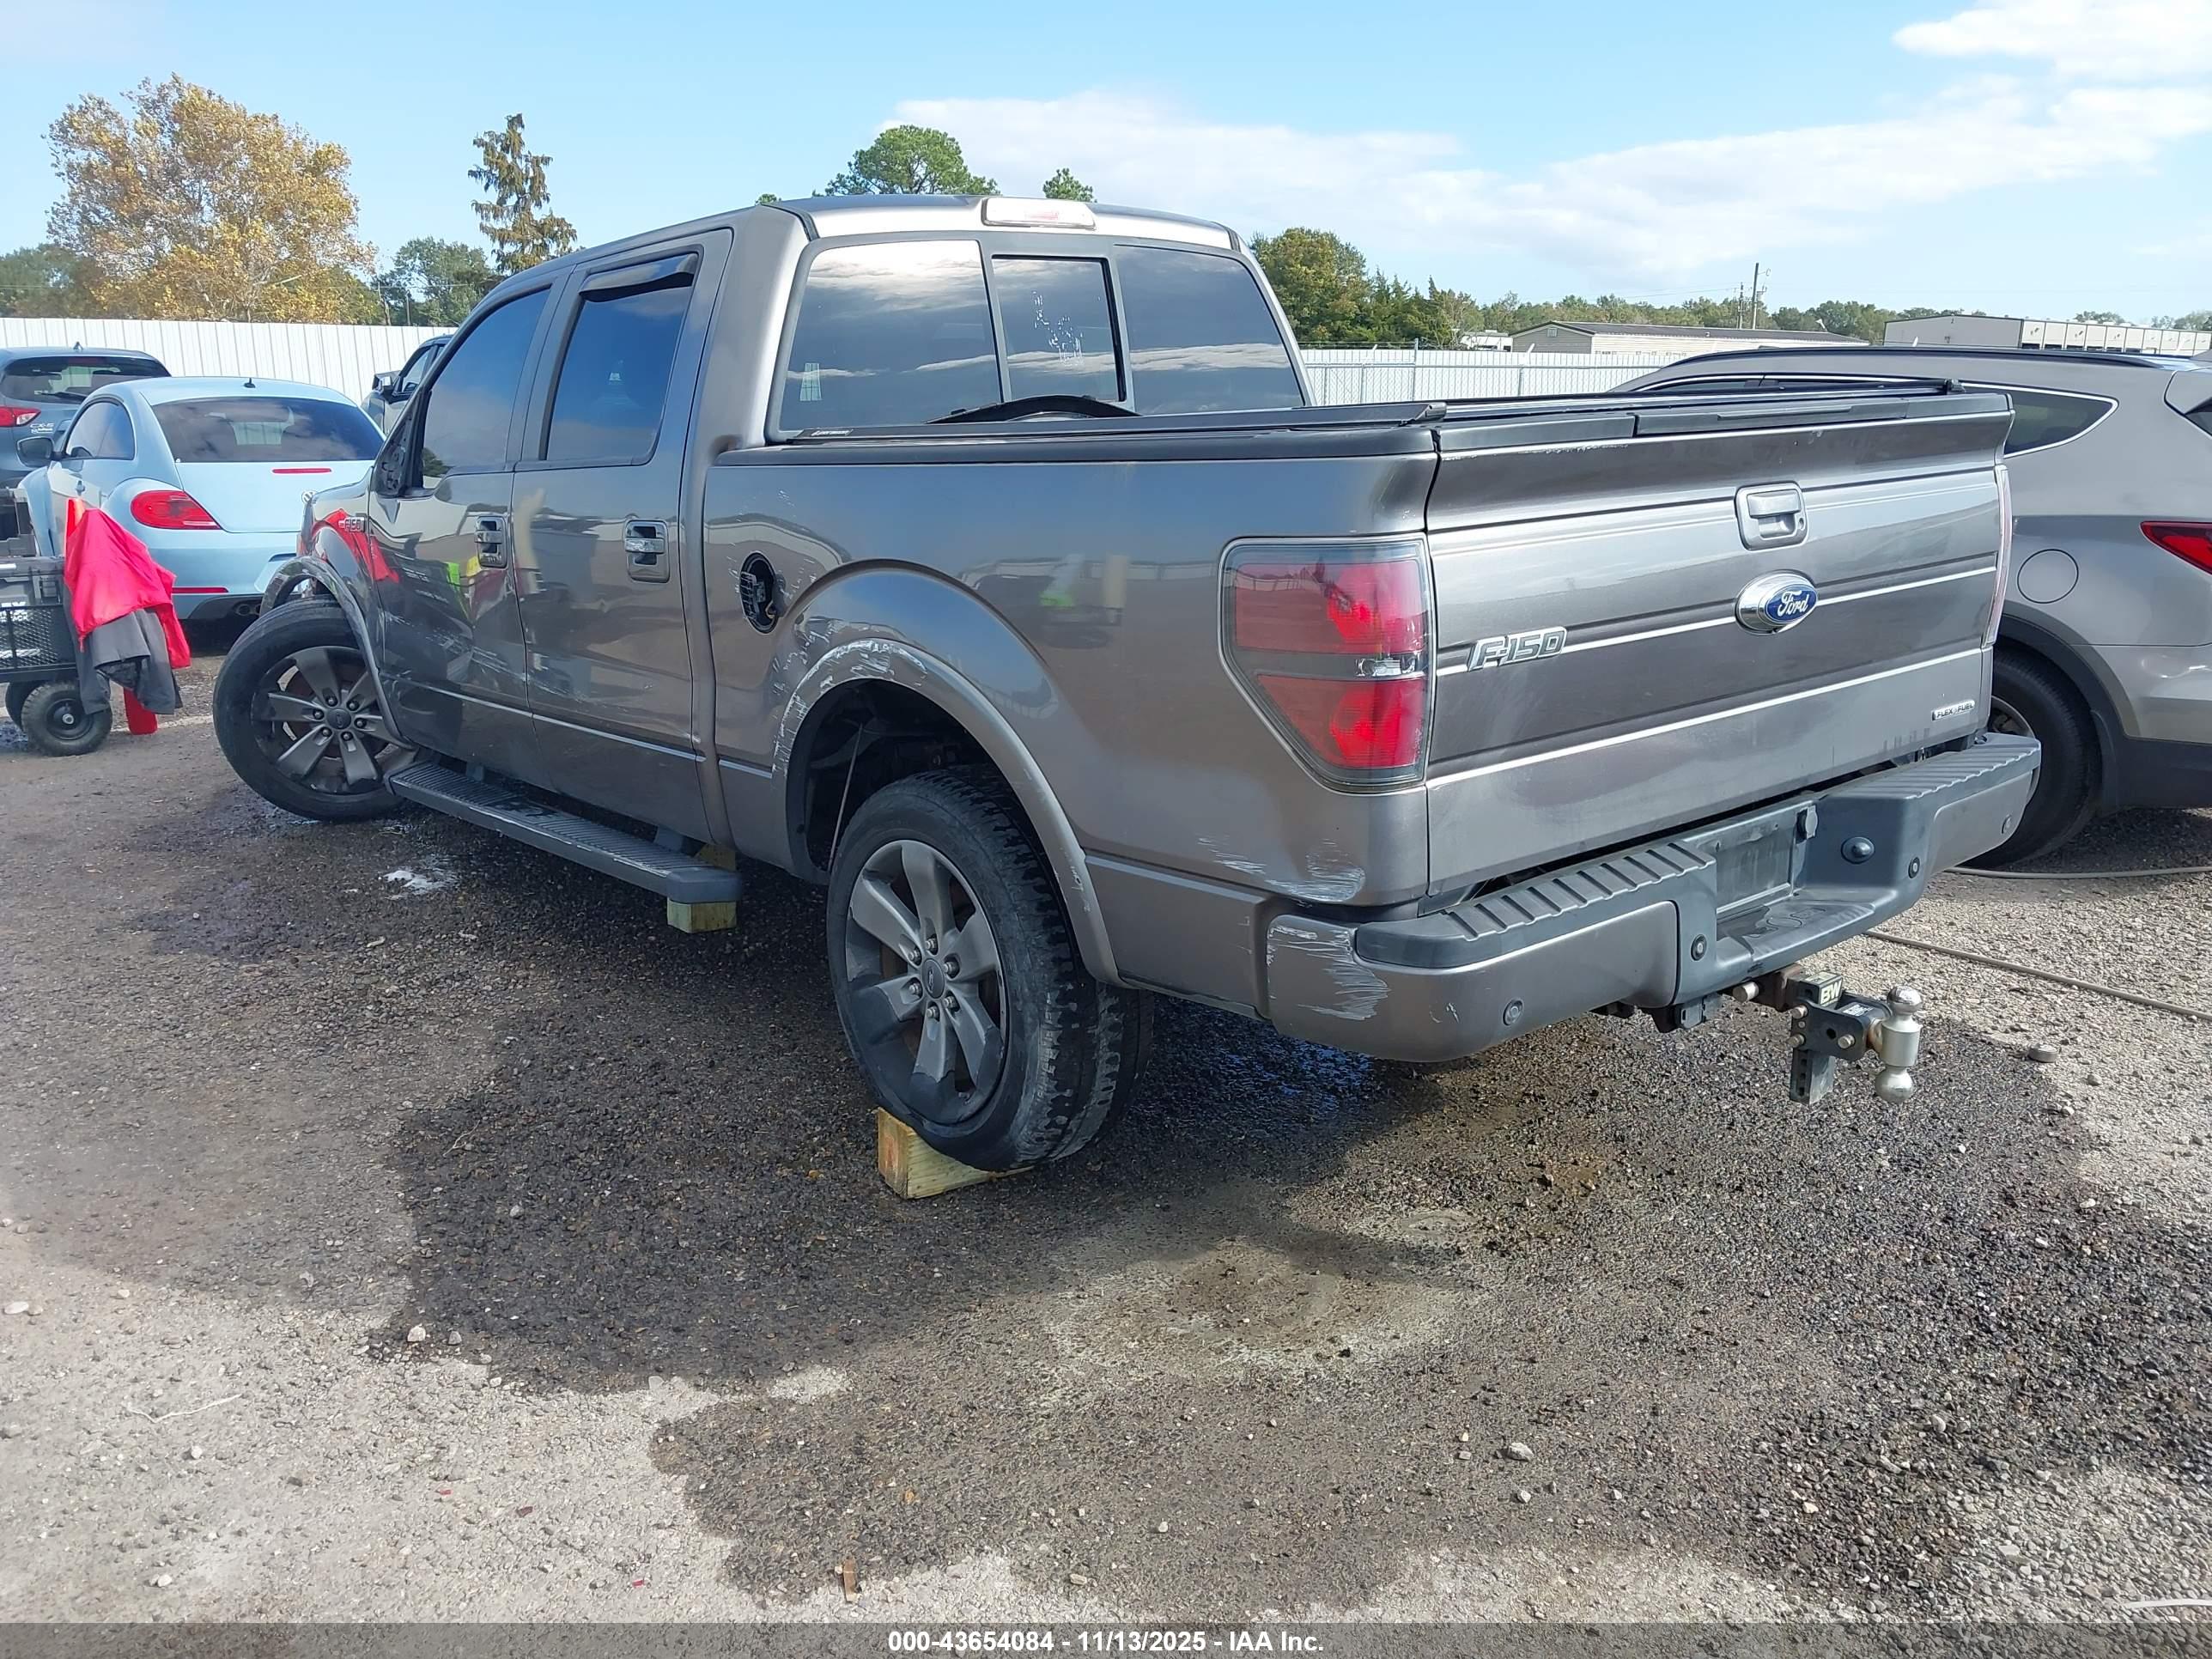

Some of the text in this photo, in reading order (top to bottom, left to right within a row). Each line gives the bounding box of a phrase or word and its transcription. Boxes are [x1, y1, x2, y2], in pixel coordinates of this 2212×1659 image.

[1777, 590, 1810, 617] Ford
[1468, 626, 1567, 672] F-150
[1936, 702, 1974, 718] FLEX FUEL
